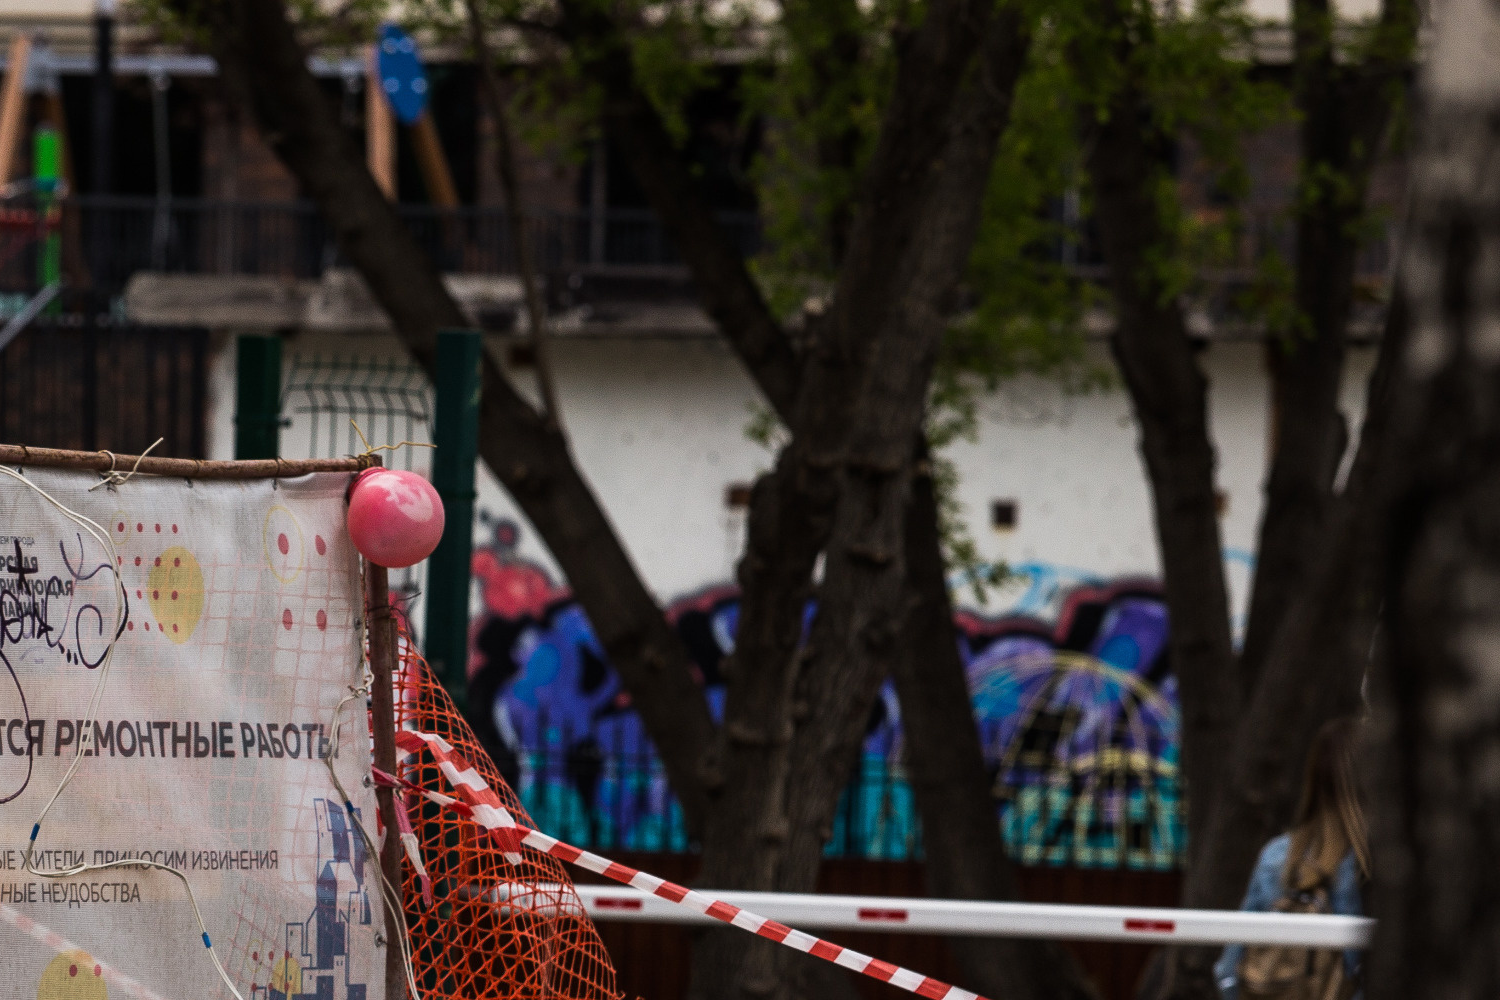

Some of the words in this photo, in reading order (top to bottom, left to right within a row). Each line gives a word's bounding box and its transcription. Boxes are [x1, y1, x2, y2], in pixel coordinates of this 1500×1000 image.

[10, 535, 36, 548] ГРОДА
[54, 718, 236, 759] РЕМОНТНЫЕ
[239, 721, 341, 760] РАБОТЫ
[20, 849, 87, 872] ЖИТЕЛИ
[93, 850, 187, 871] ПРИНОСИМ
[191, 850, 279, 871] ИЗВИНЕНИЯ
[41, 883, 141, 909] НЕУДОБСТВА
